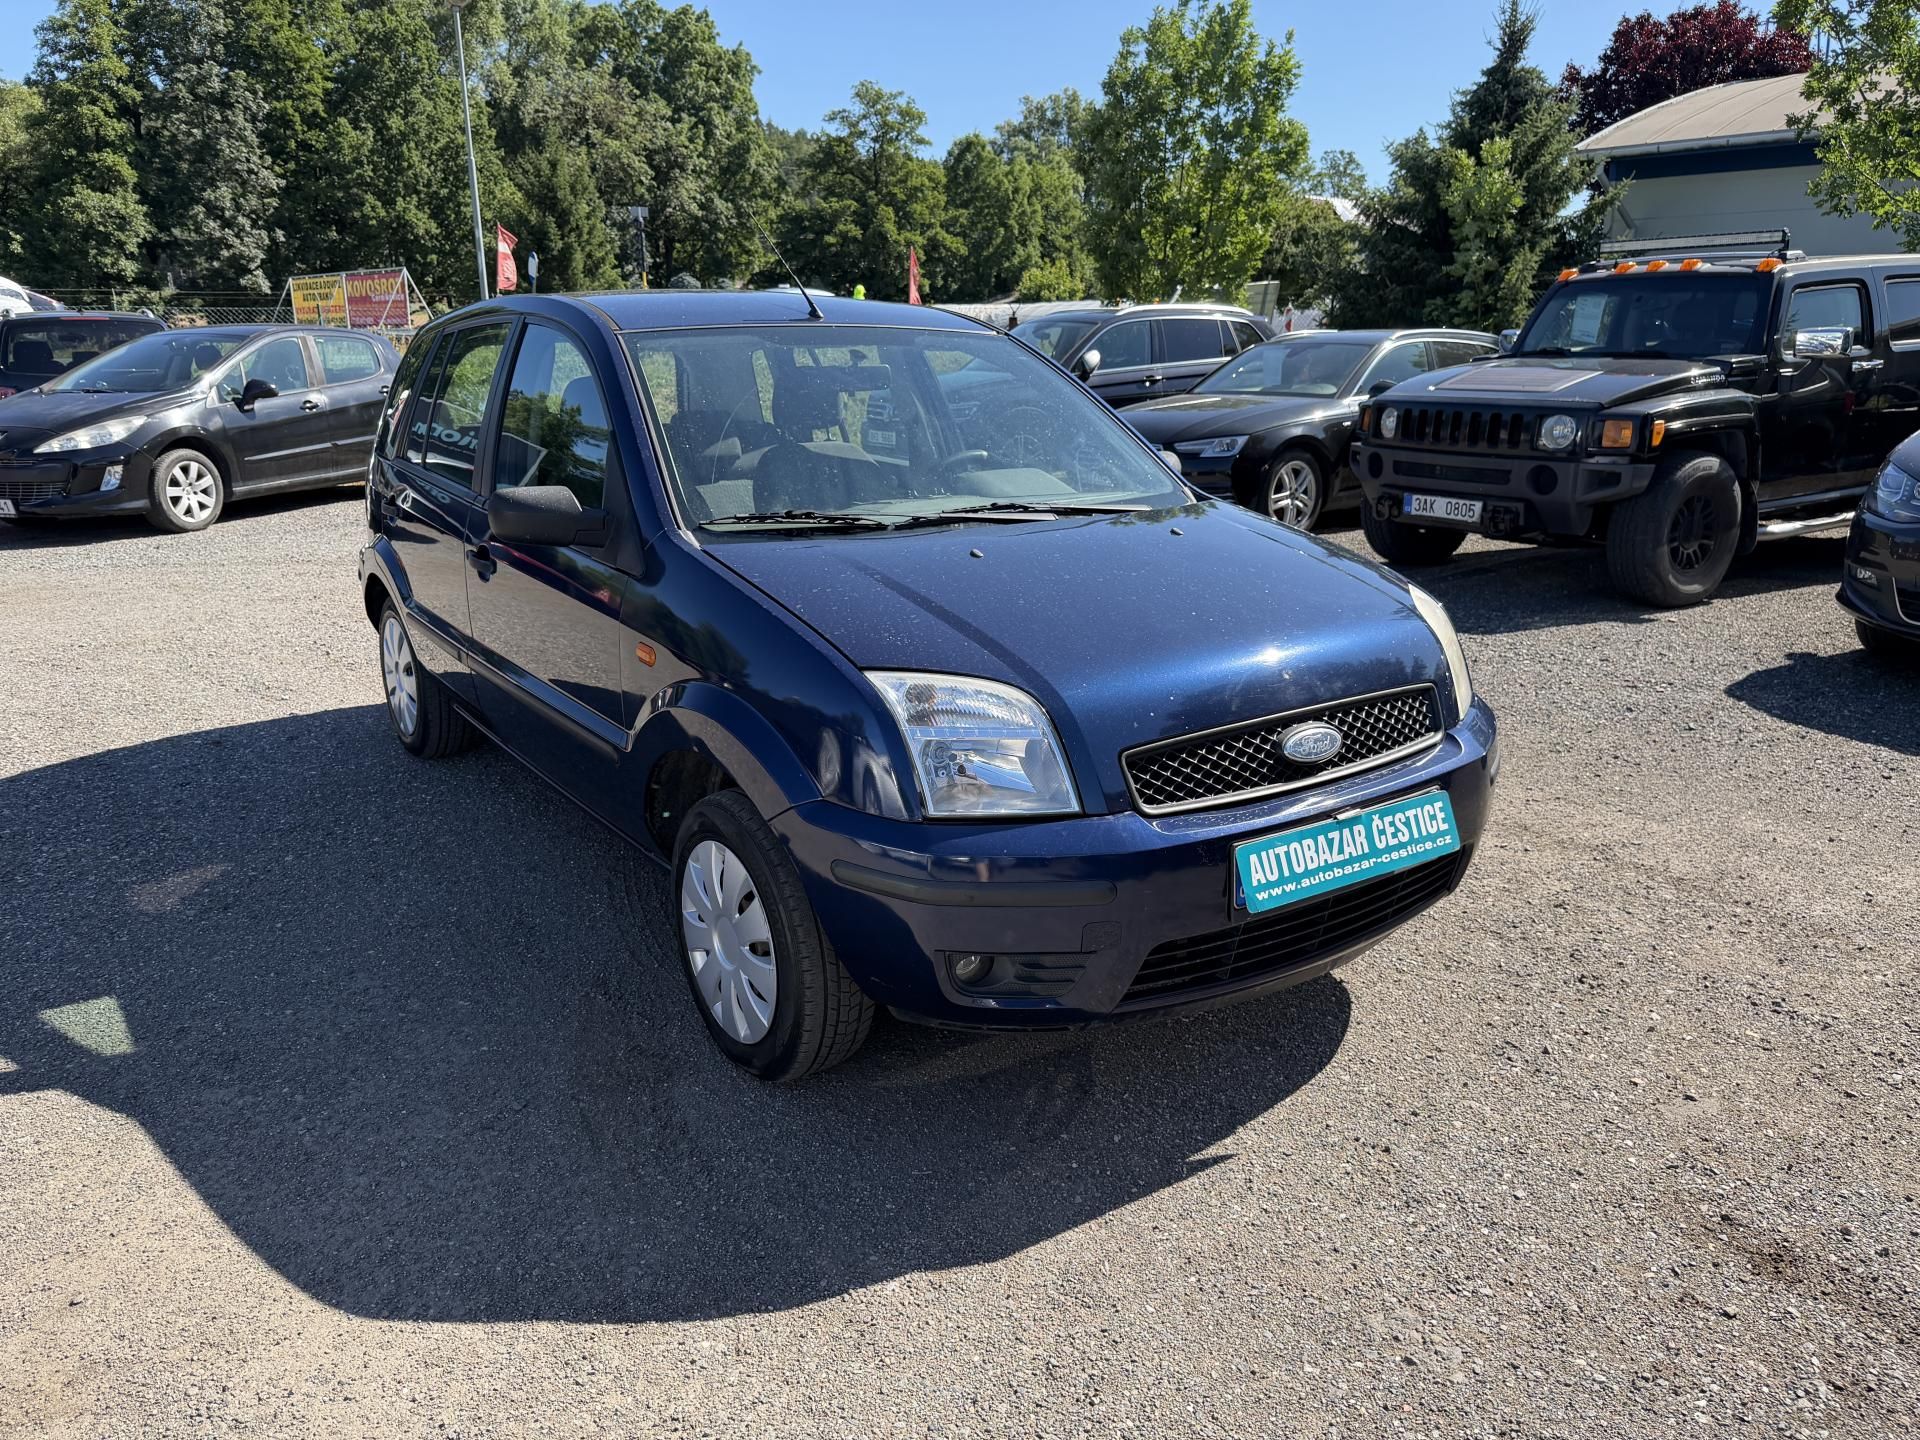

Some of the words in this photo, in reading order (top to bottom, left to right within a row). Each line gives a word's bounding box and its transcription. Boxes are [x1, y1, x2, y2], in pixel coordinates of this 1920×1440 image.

[1414, 497, 1436, 513] 3AK
[1445, 501, 1476, 519] 0805
[1300, 733, 1331, 754] Ford
[1249, 824, 1368, 887] AUTOBAZAR
[1372, 800, 1449, 850] ČESTICE
[1256, 834, 1452, 901] www.autobazar-cestice.cz
